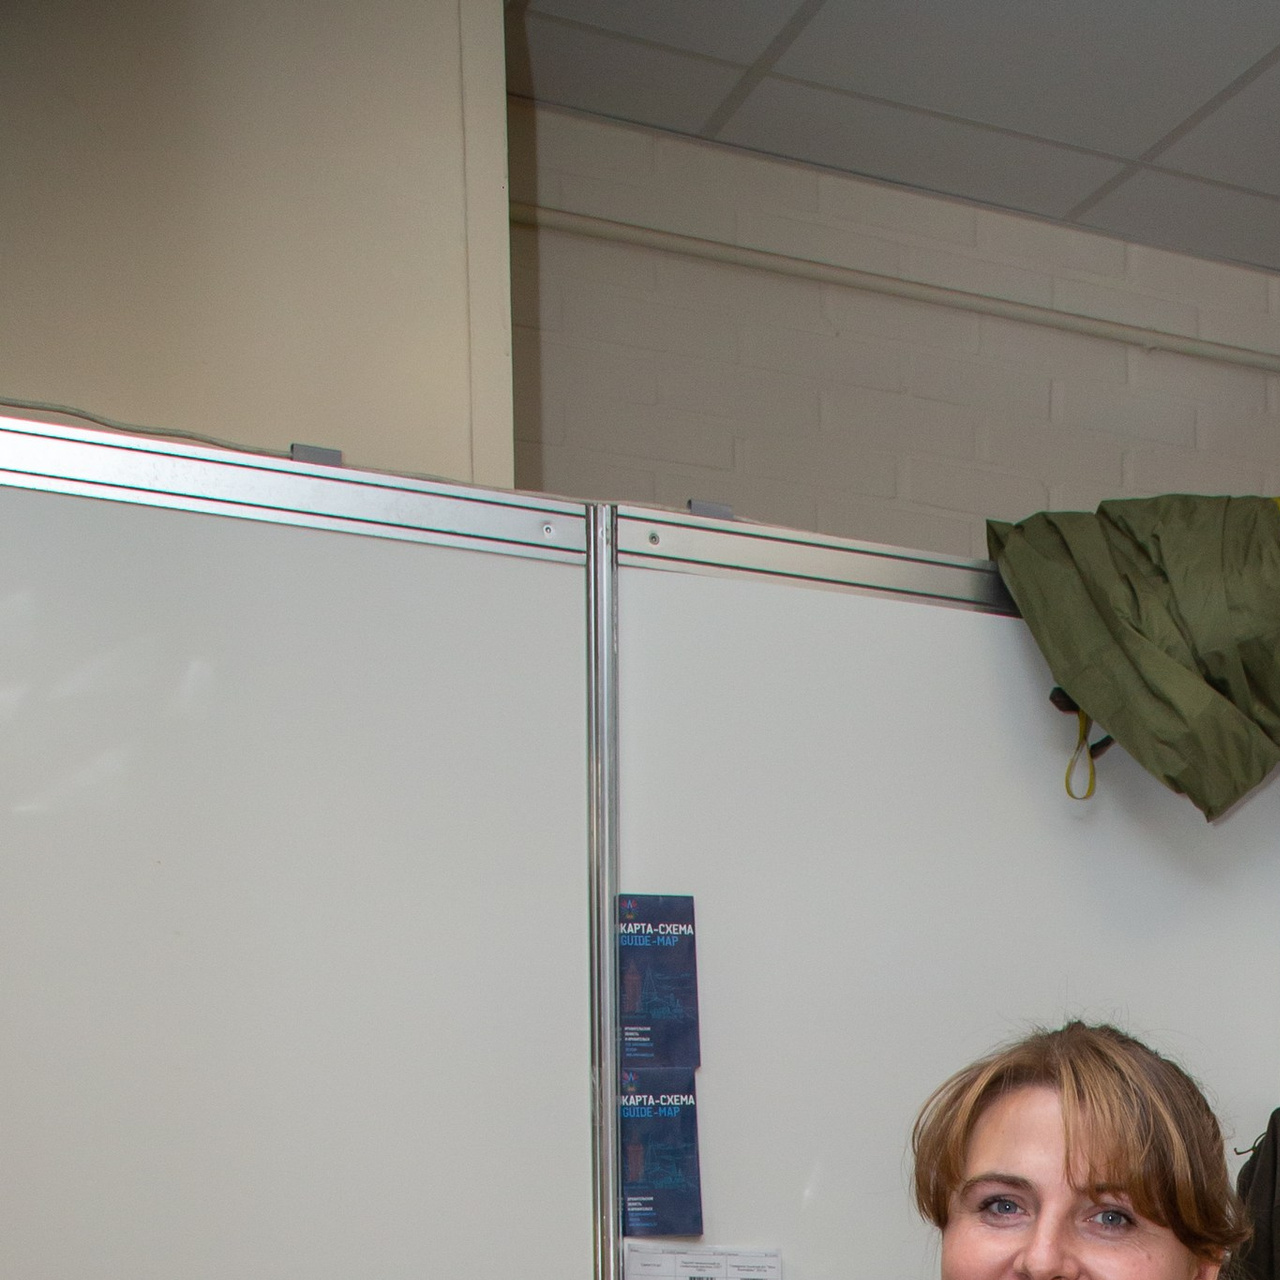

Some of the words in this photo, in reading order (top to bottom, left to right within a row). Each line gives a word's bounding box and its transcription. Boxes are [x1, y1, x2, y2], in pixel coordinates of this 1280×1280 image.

[620, 923, 694, 935] КАРТА-СХЕМА
[620, 935, 679, 946] GUIDE-MAP
[622, 1095, 695, 1106] КАРТА-СХЕМА
[622, 1107, 680, 1118] GUIDE-MAP
